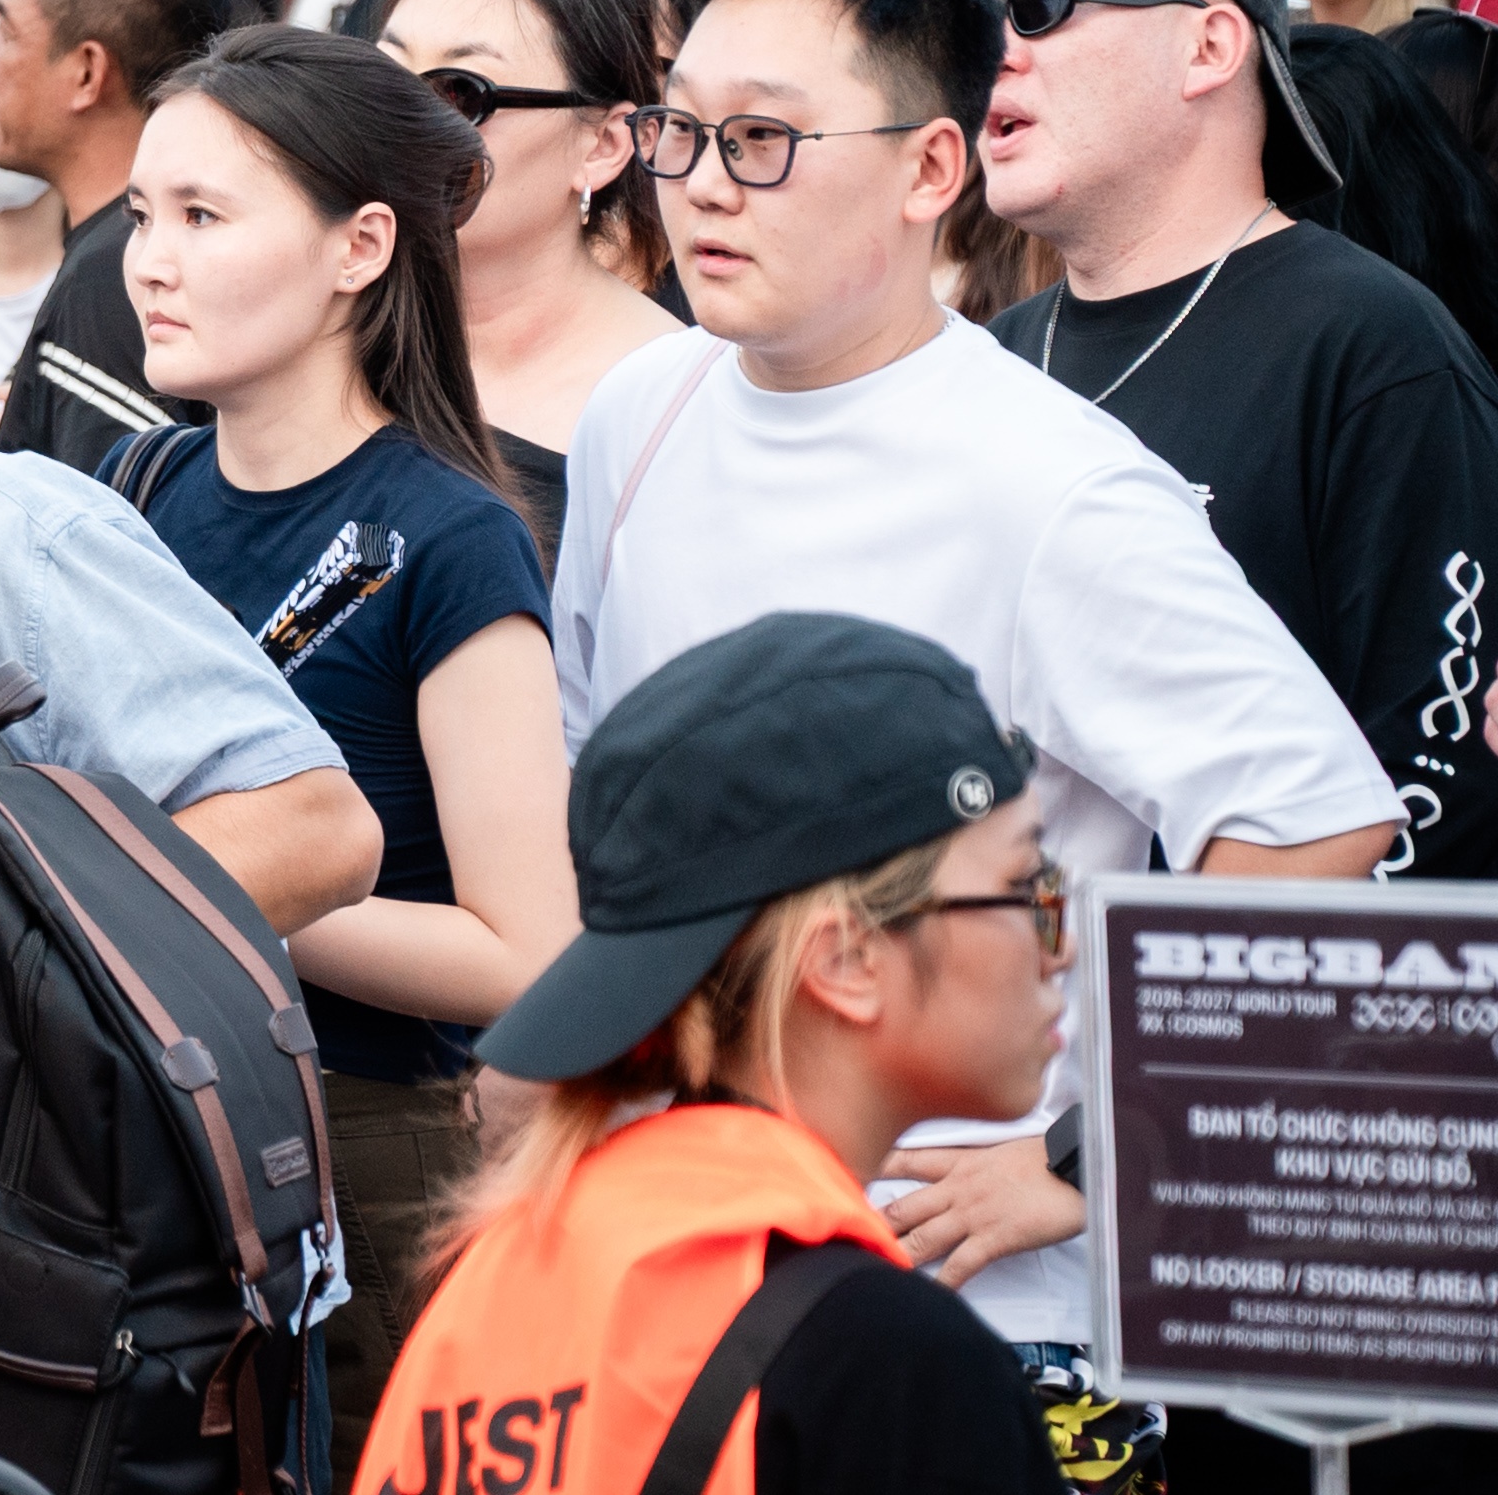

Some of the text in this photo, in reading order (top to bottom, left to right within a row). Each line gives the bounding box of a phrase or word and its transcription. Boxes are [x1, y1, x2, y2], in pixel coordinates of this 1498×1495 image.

[1134, 931, 1498, 993] BIGBAN
[1187, 1104, 1243, 1140] BAN
[1350, 1108, 1439, 1150] KHÔNG
[1439, 1115, 1498, 1152] CUN
[1274, 1148, 1331, 1181] KHU
[1151, 1253, 1191, 1288] NO
[1192, 1256, 1286, 1294] LOCKER
[1303, 1261, 1416, 1302] STORAGE
[1416, 1270, 1485, 1307] AREA
[379, 1384, 585, 1495] UEST
